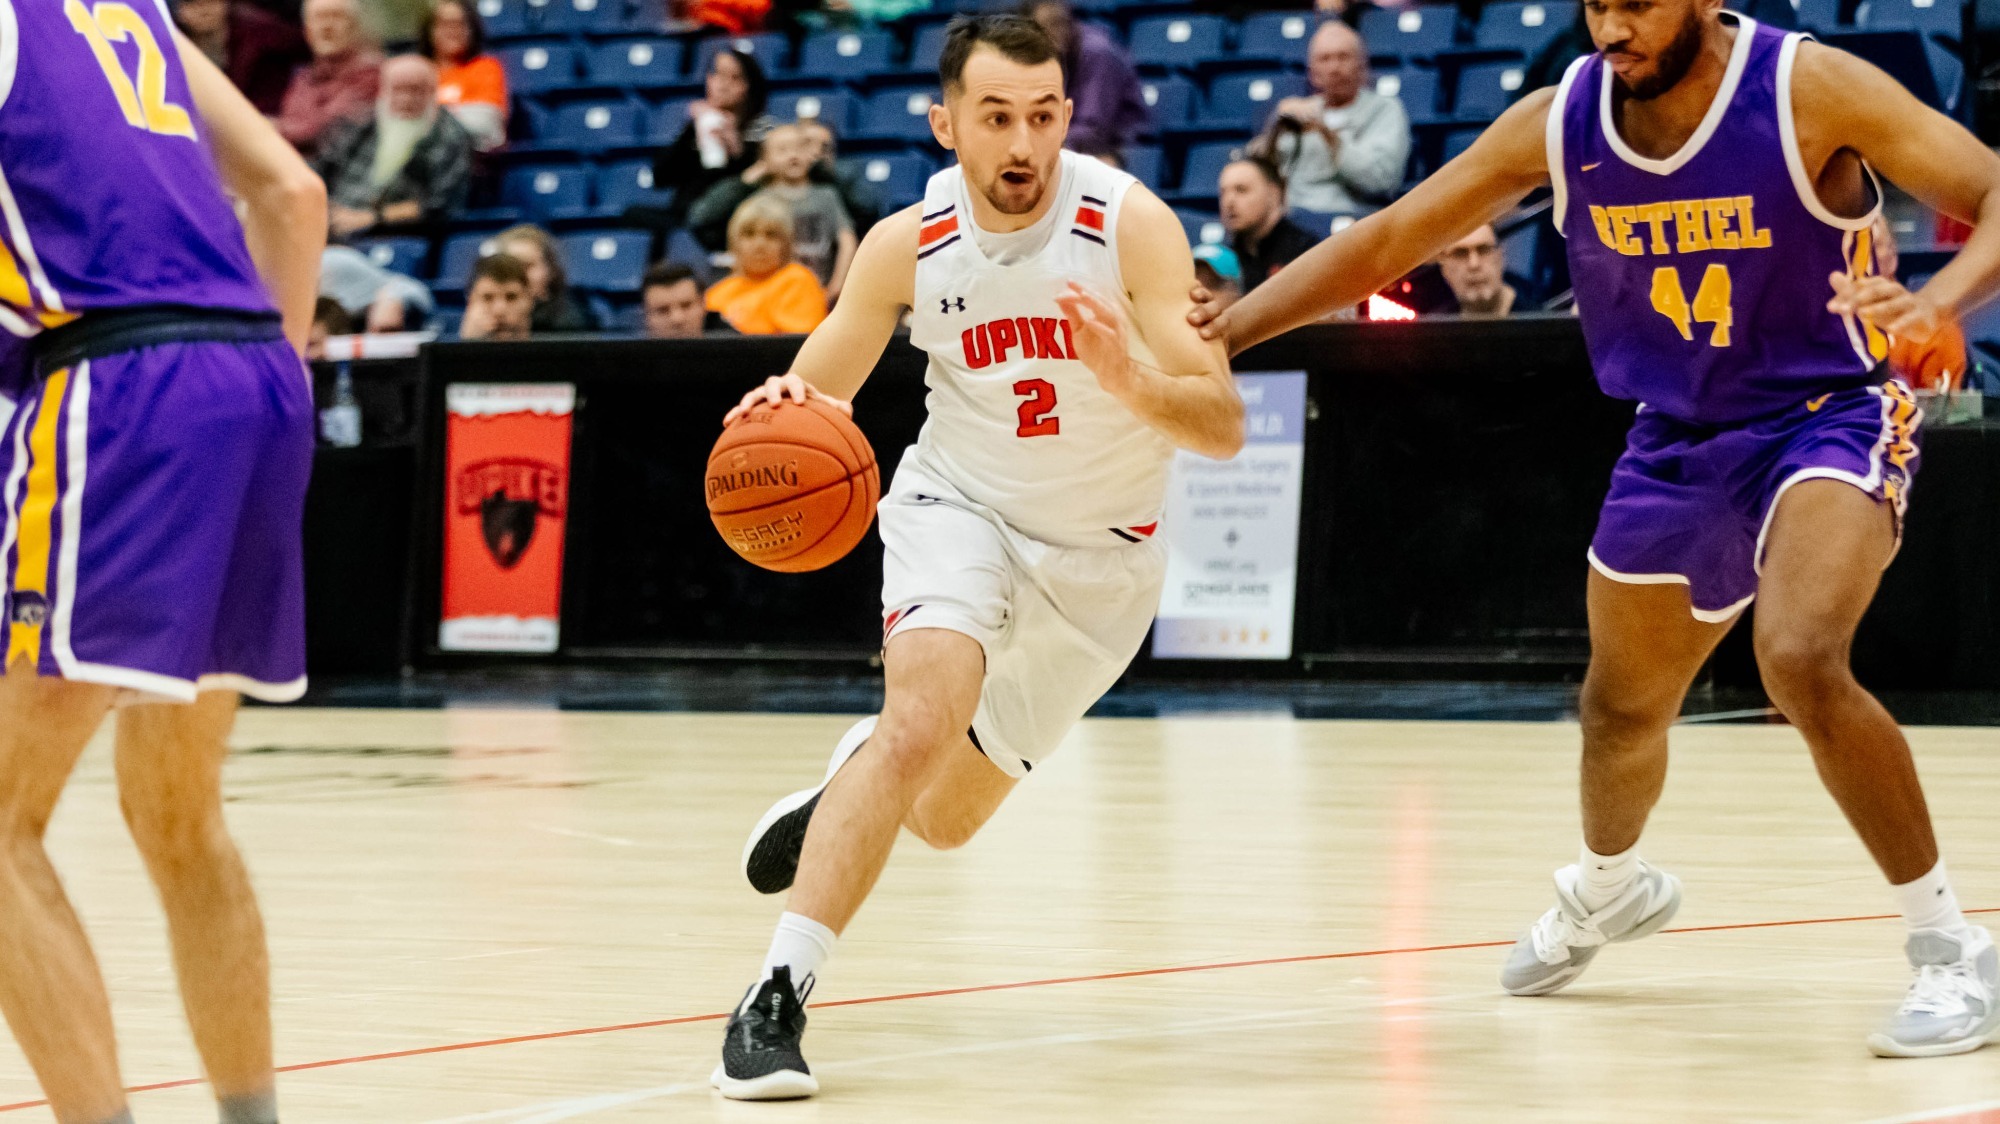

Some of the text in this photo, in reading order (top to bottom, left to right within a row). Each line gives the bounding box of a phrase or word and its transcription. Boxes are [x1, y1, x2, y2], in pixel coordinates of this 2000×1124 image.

[64, 0, 198, 142] 12
[1588, 195, 1772, 256] BETHEL
[1650, 263, 1732, 347] 44
[1013, 378, 1059, 437] 2
[708, 461, 798, 502] PALDING
[732, 511, 803, 541] EGACY
